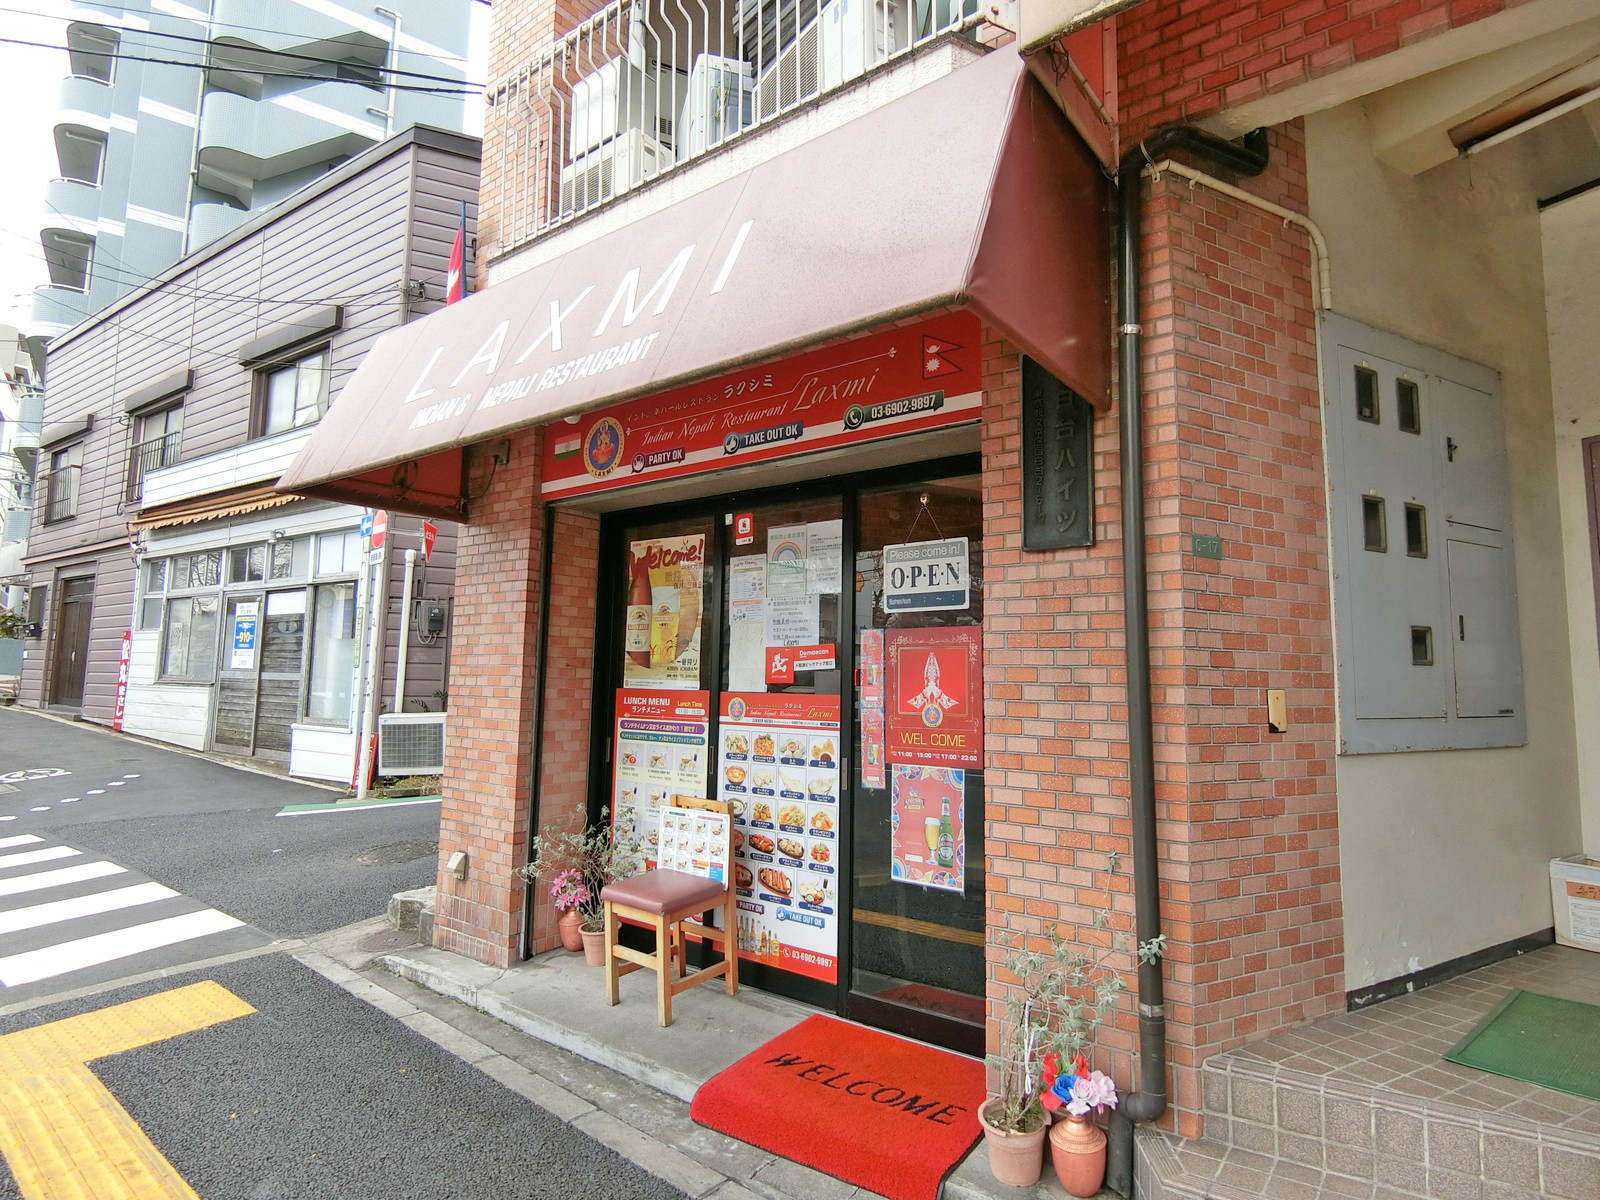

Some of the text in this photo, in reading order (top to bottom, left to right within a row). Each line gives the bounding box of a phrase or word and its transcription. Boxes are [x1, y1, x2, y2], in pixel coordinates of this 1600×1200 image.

[404, 219, 755, 404] LAXMI
[408, 399, 455, 430] INDIAN
[477, 376, 537, 411] NEPALI
[535, 331, 660, 392] RESTAURANT
[724, 374, 773, 399] ラクシミ
[642, 367, 880, 447] Indian Nepali Restaurant Laxmi
[871, 394, 936, 419] 03-6902-9897
[744, 424, 799, 446] TAKE OUT OK
[648, 449, 683, 465] PARTY OK
[594, 466, 614, 477] LAXMI
[629, 539, 705, 579] Welcome!
[889, 544, 961, 560] Please come in!
[623, 697, 671, 706] LUNCH MENU
[632, 706, 666, 714] ランチメニュー
[806, 707, 834, 718] Laxmi
[900, 732, 966, 747] WEL COME
[739, 901, 763, 913] PARTY OK
[789, 913, 823, 926] TAKE OUT OK
[791, 950, 833, 968] 03-6902-9897
[763, 1053, 967, 1126] WELCOME
